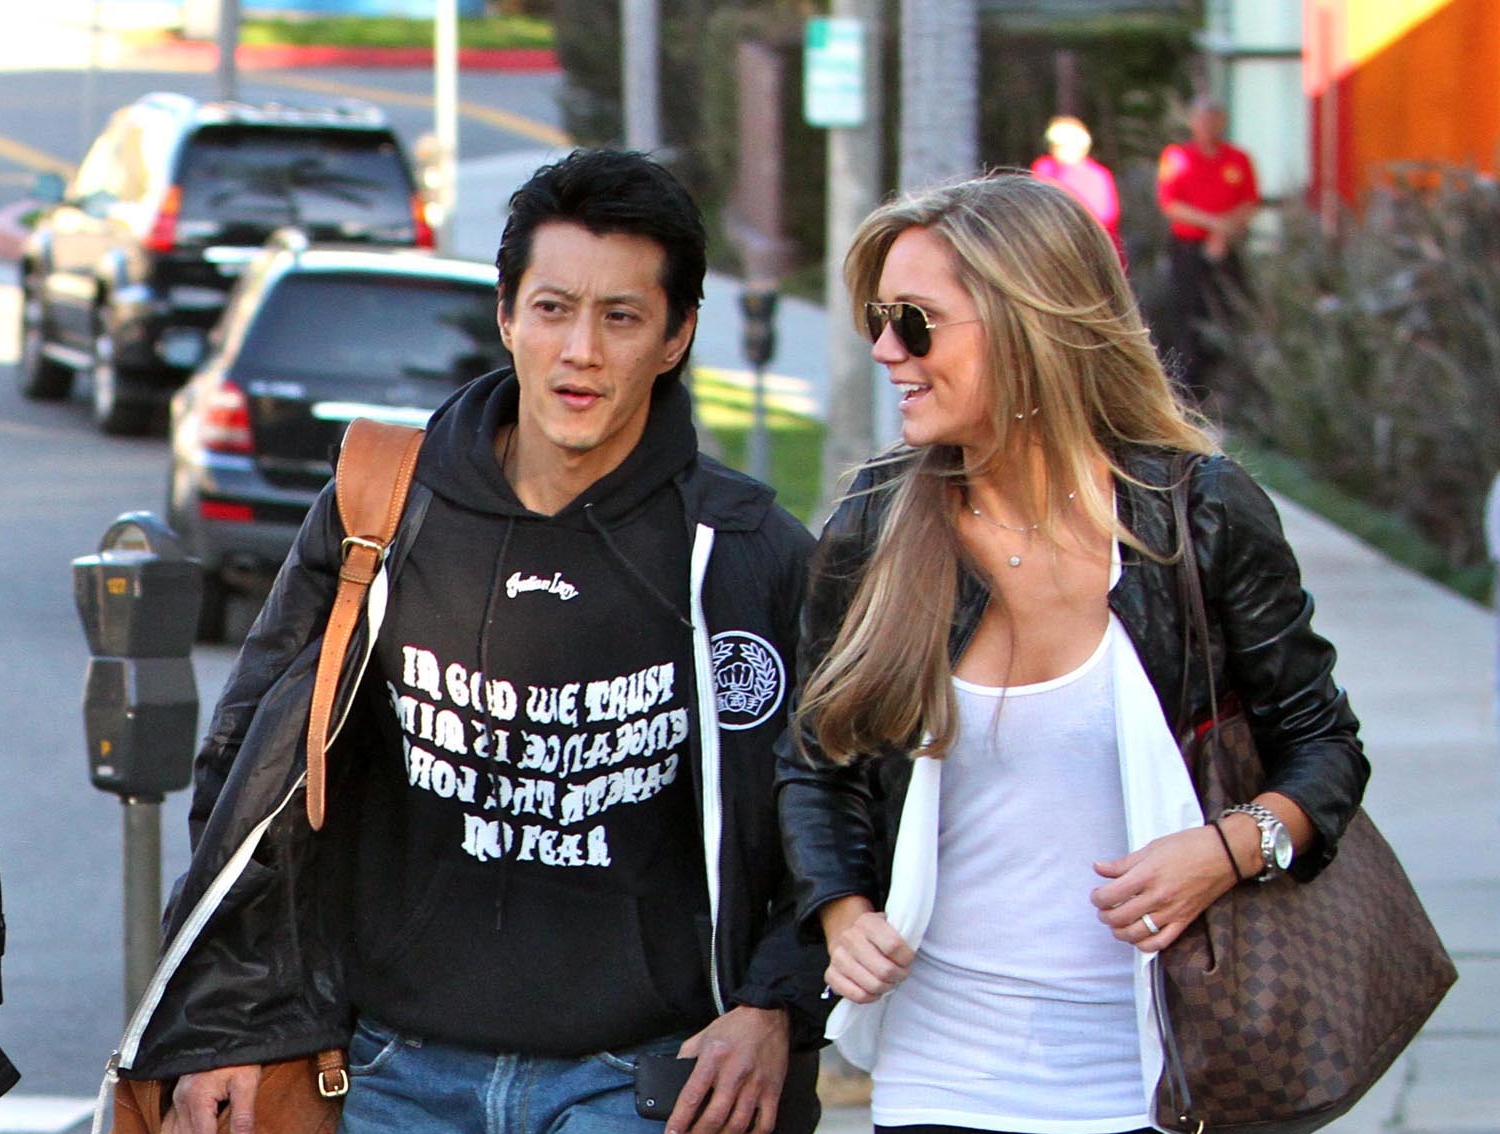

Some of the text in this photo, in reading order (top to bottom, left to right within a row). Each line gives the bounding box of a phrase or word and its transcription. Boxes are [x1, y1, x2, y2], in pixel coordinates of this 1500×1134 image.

[445, 662, 518, 722] GOD
[526, 681, 581, 728] WE
[585, 661, 675, 724] TRUST
[461, 812, 612, 868] NO FEAR
